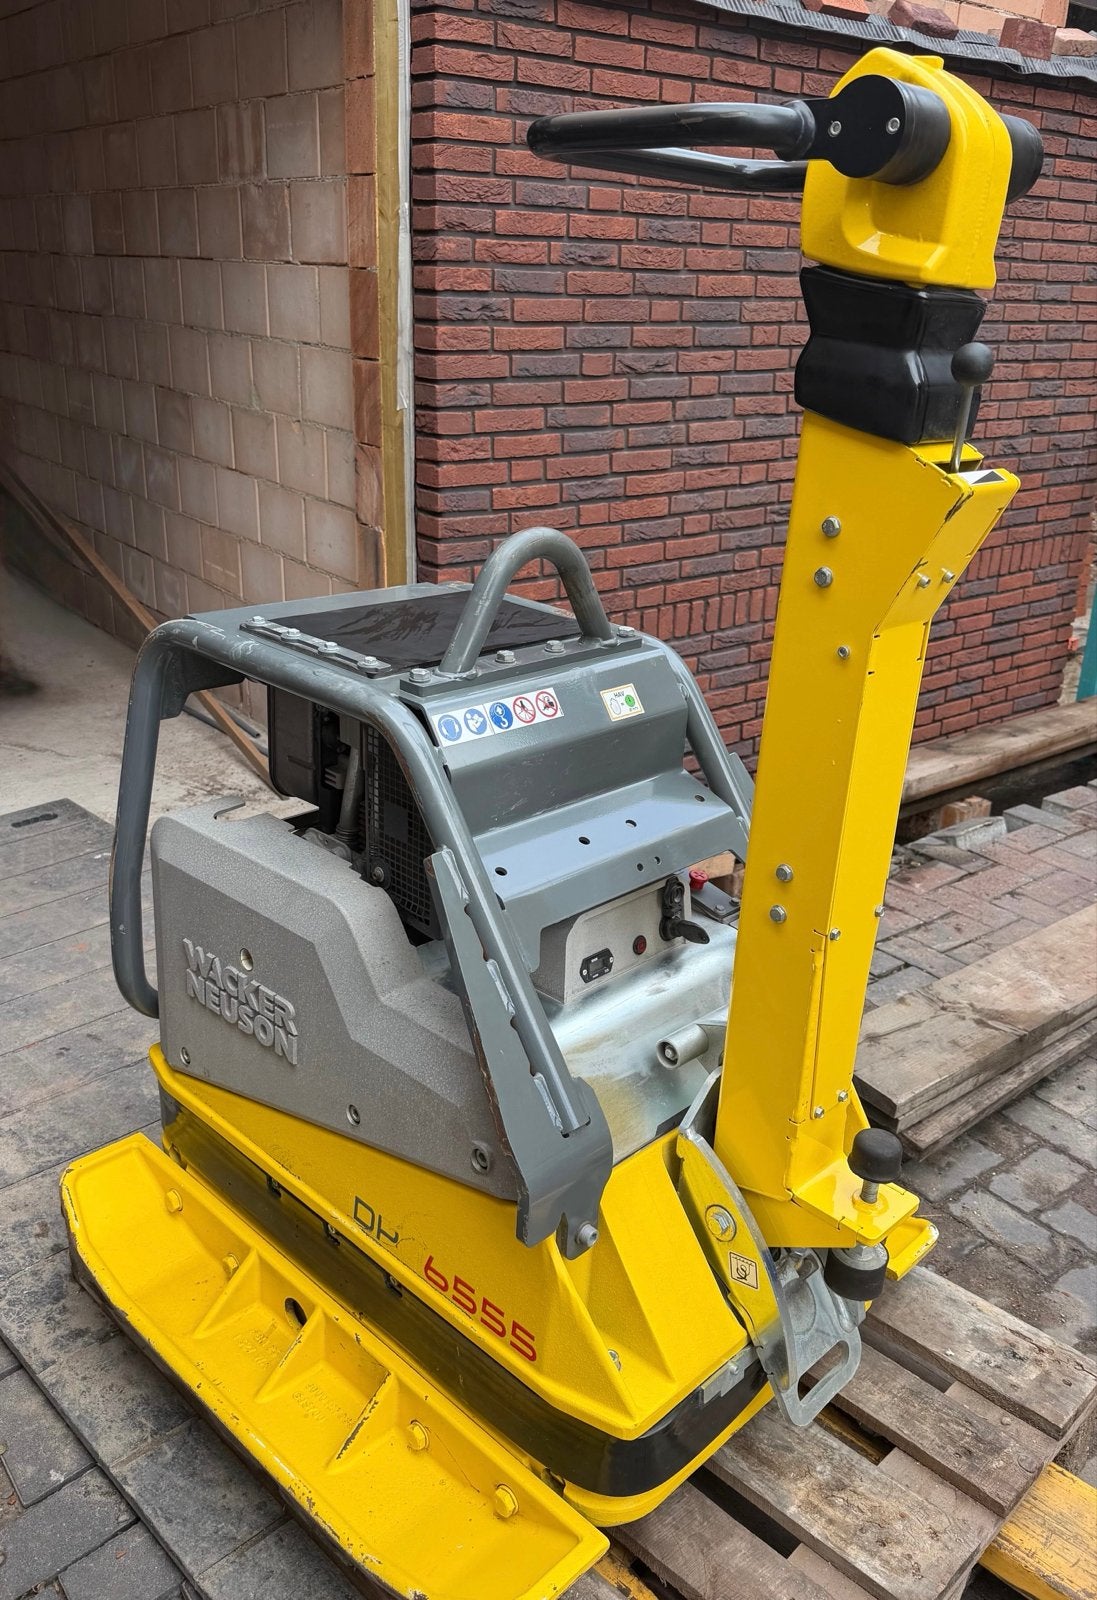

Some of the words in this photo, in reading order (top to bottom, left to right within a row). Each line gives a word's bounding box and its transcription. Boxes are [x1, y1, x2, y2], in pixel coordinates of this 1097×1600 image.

[183, 937, 298, 1037] WACKER
[186, 968, 298, 1065] NEUSON
[423, 1255, 537, 1362] 6555
